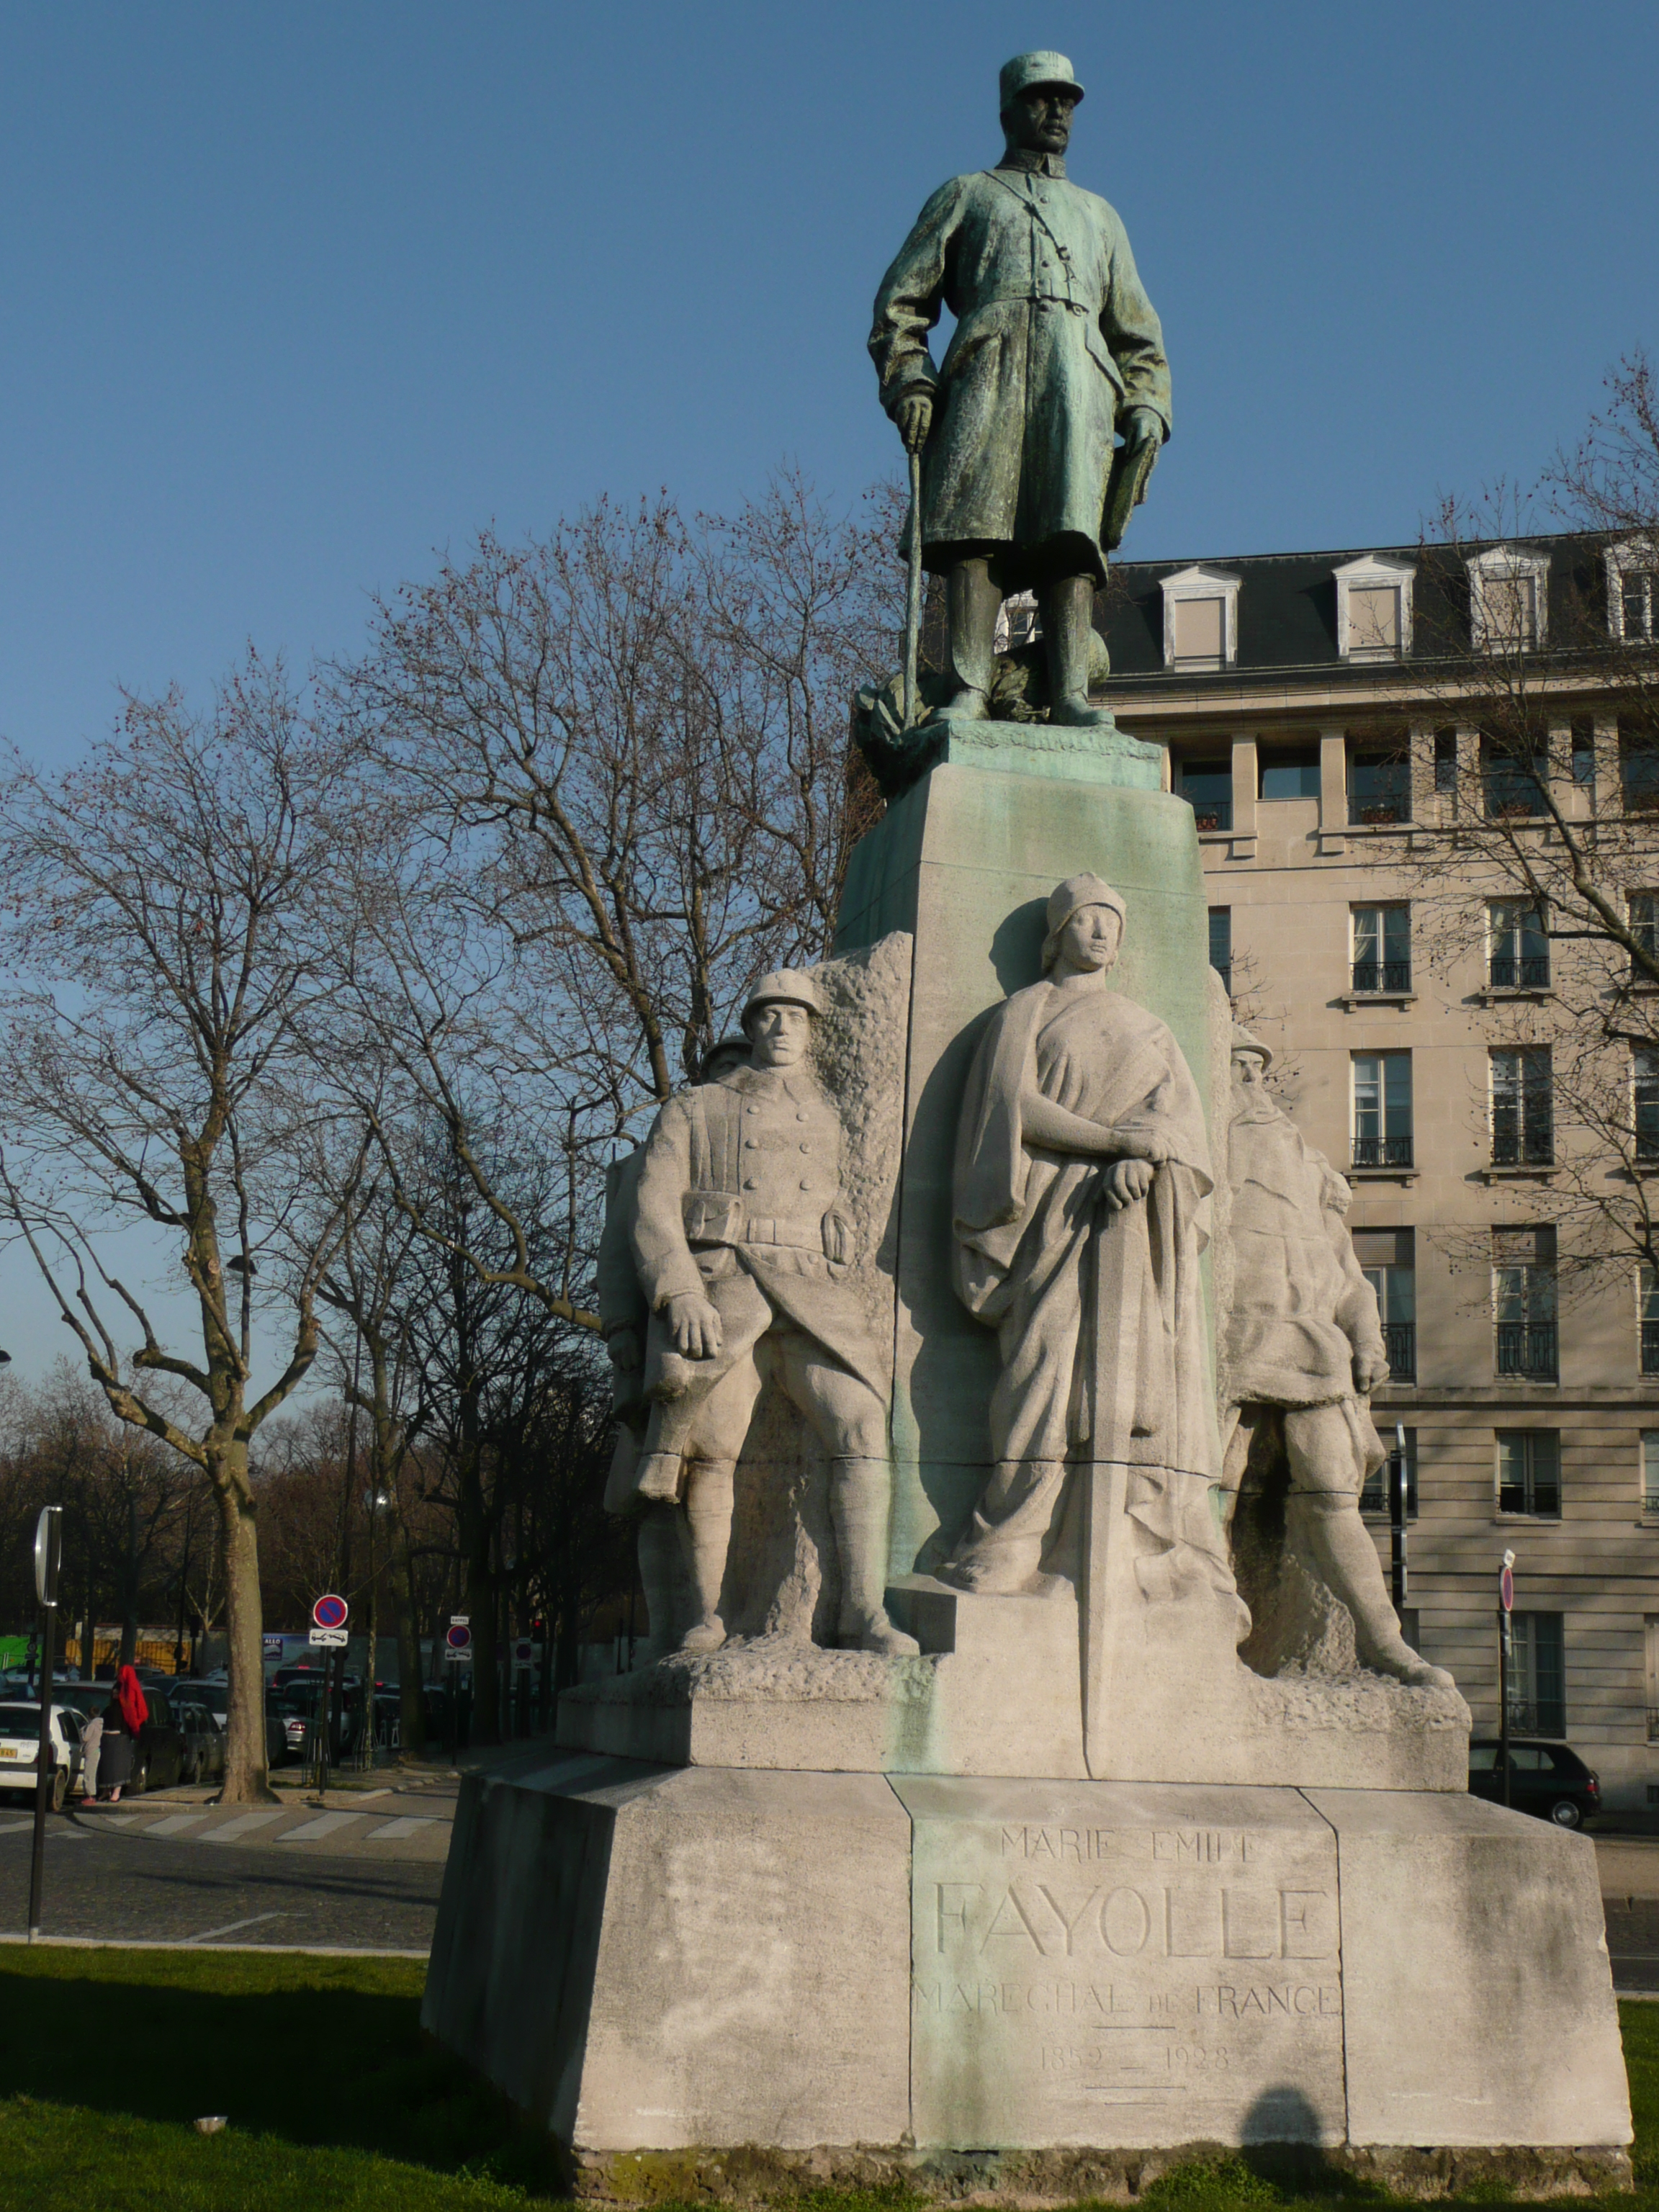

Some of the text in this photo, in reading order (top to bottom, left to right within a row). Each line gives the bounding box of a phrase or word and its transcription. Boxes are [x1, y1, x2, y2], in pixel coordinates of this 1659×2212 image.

[1002, 1827, 1261, 1863] MARIE EMILE
[933, 1881, 1329, 1960] FAYOLLE
[1149, 1993, 1179, 2014] DE
[1197, 1985, 1340, 2018] FRANCE
[1041, 2046, 1228, 2070] 1852 1928
